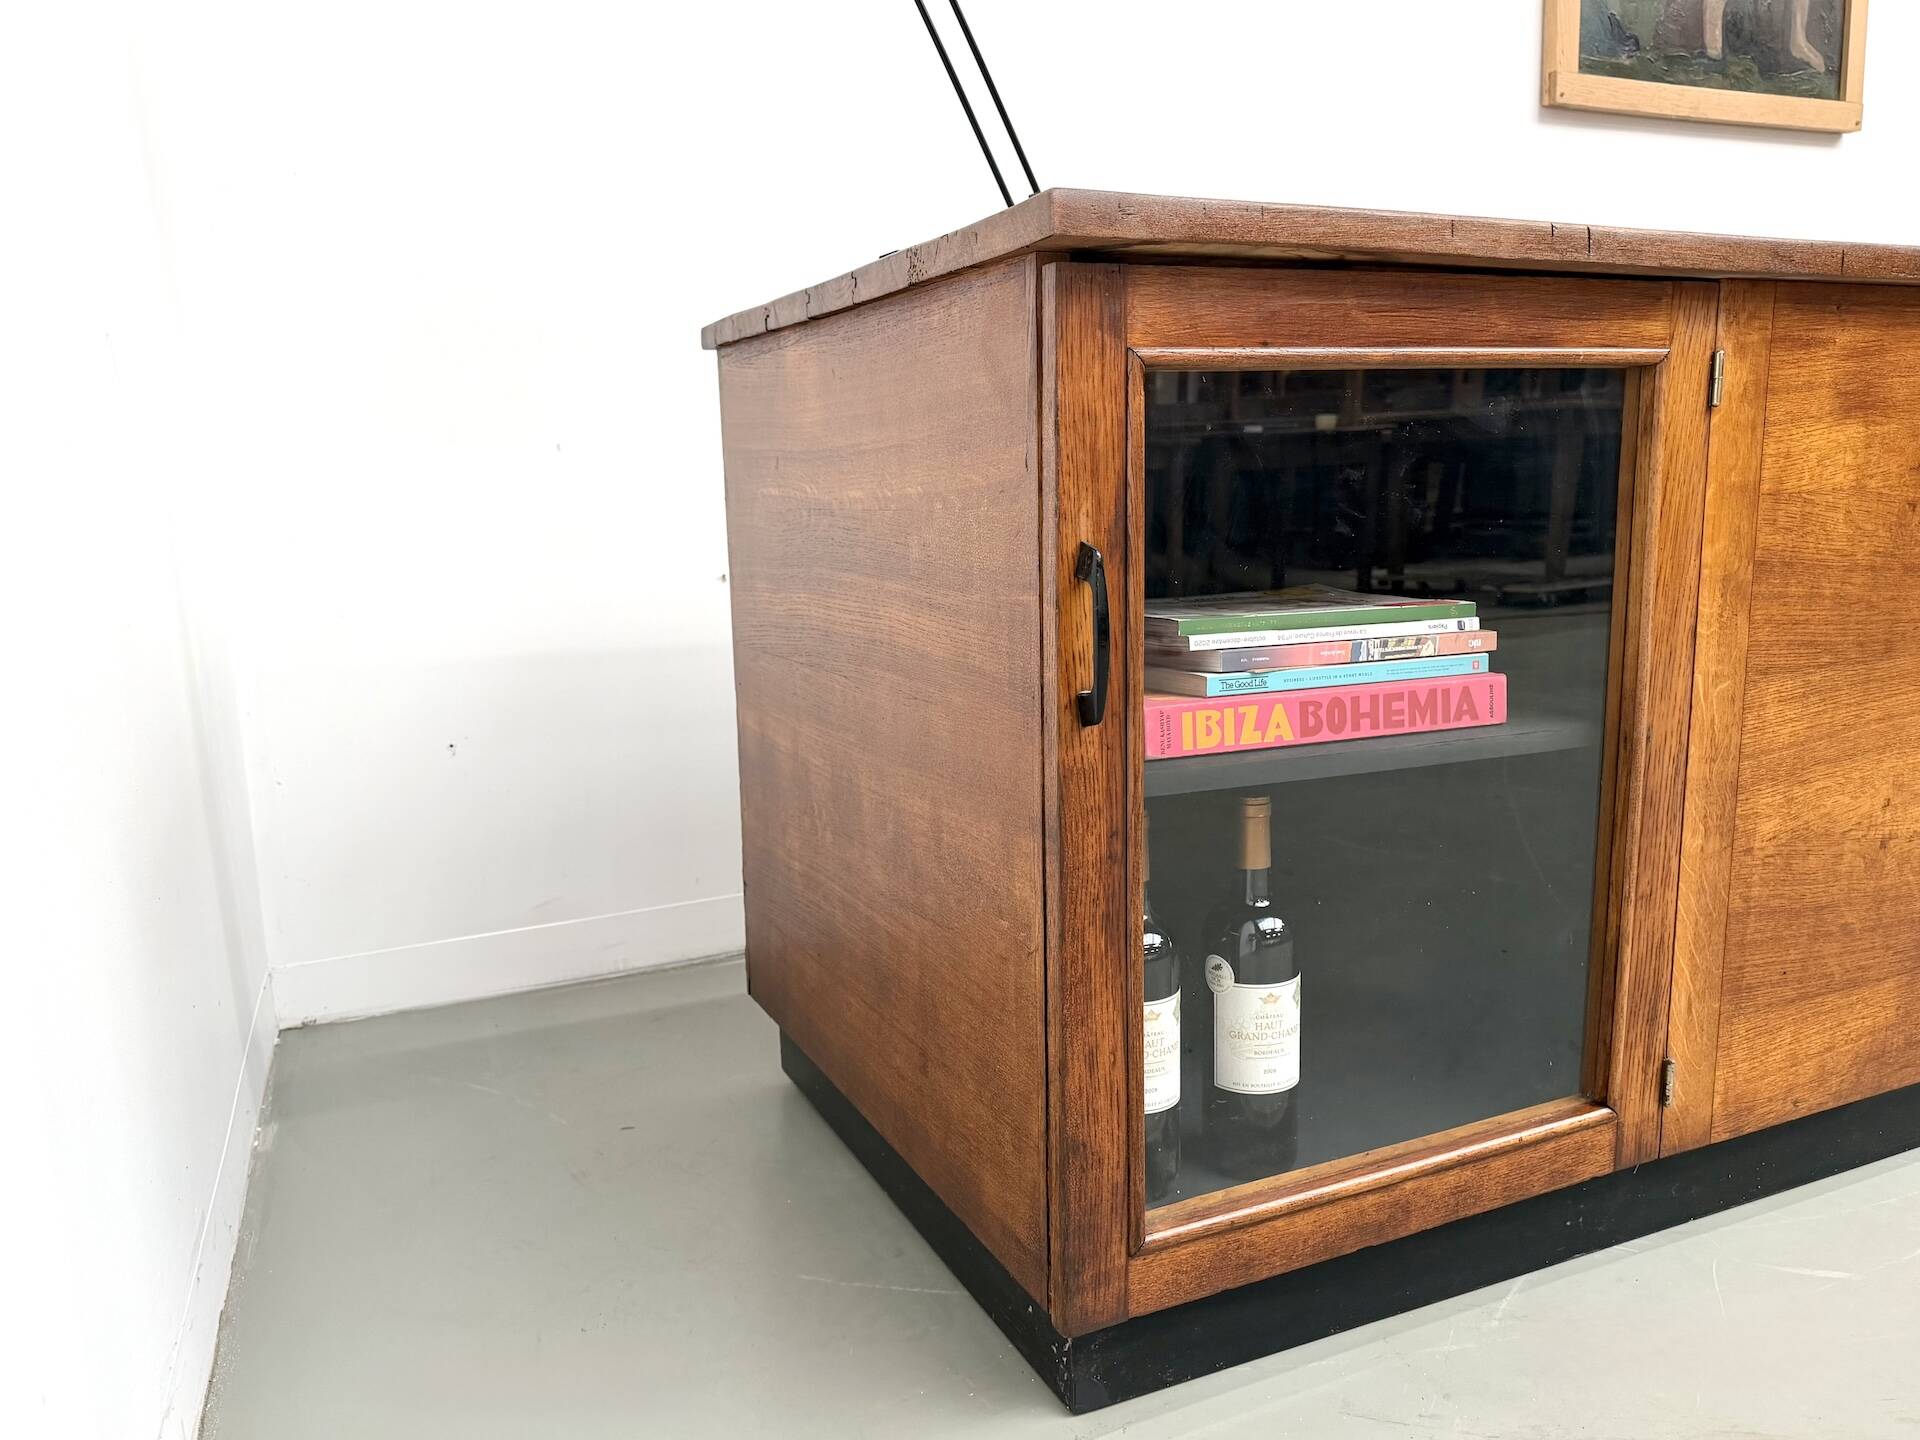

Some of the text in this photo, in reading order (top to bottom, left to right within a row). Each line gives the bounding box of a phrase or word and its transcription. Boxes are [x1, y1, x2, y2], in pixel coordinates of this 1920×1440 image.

[1194, 639, 1211, 647] 2020
[1220, 677, 1268, 690] The Good Life
[1182, 686, 1480, 752] IBIZA BOHEMIA
[1255, 1020, 1284, 1031] HAUT
[1144, 1037, 1165, 1049] AUT
[1253, 1048, 1285, 1056] BORDEAUX
